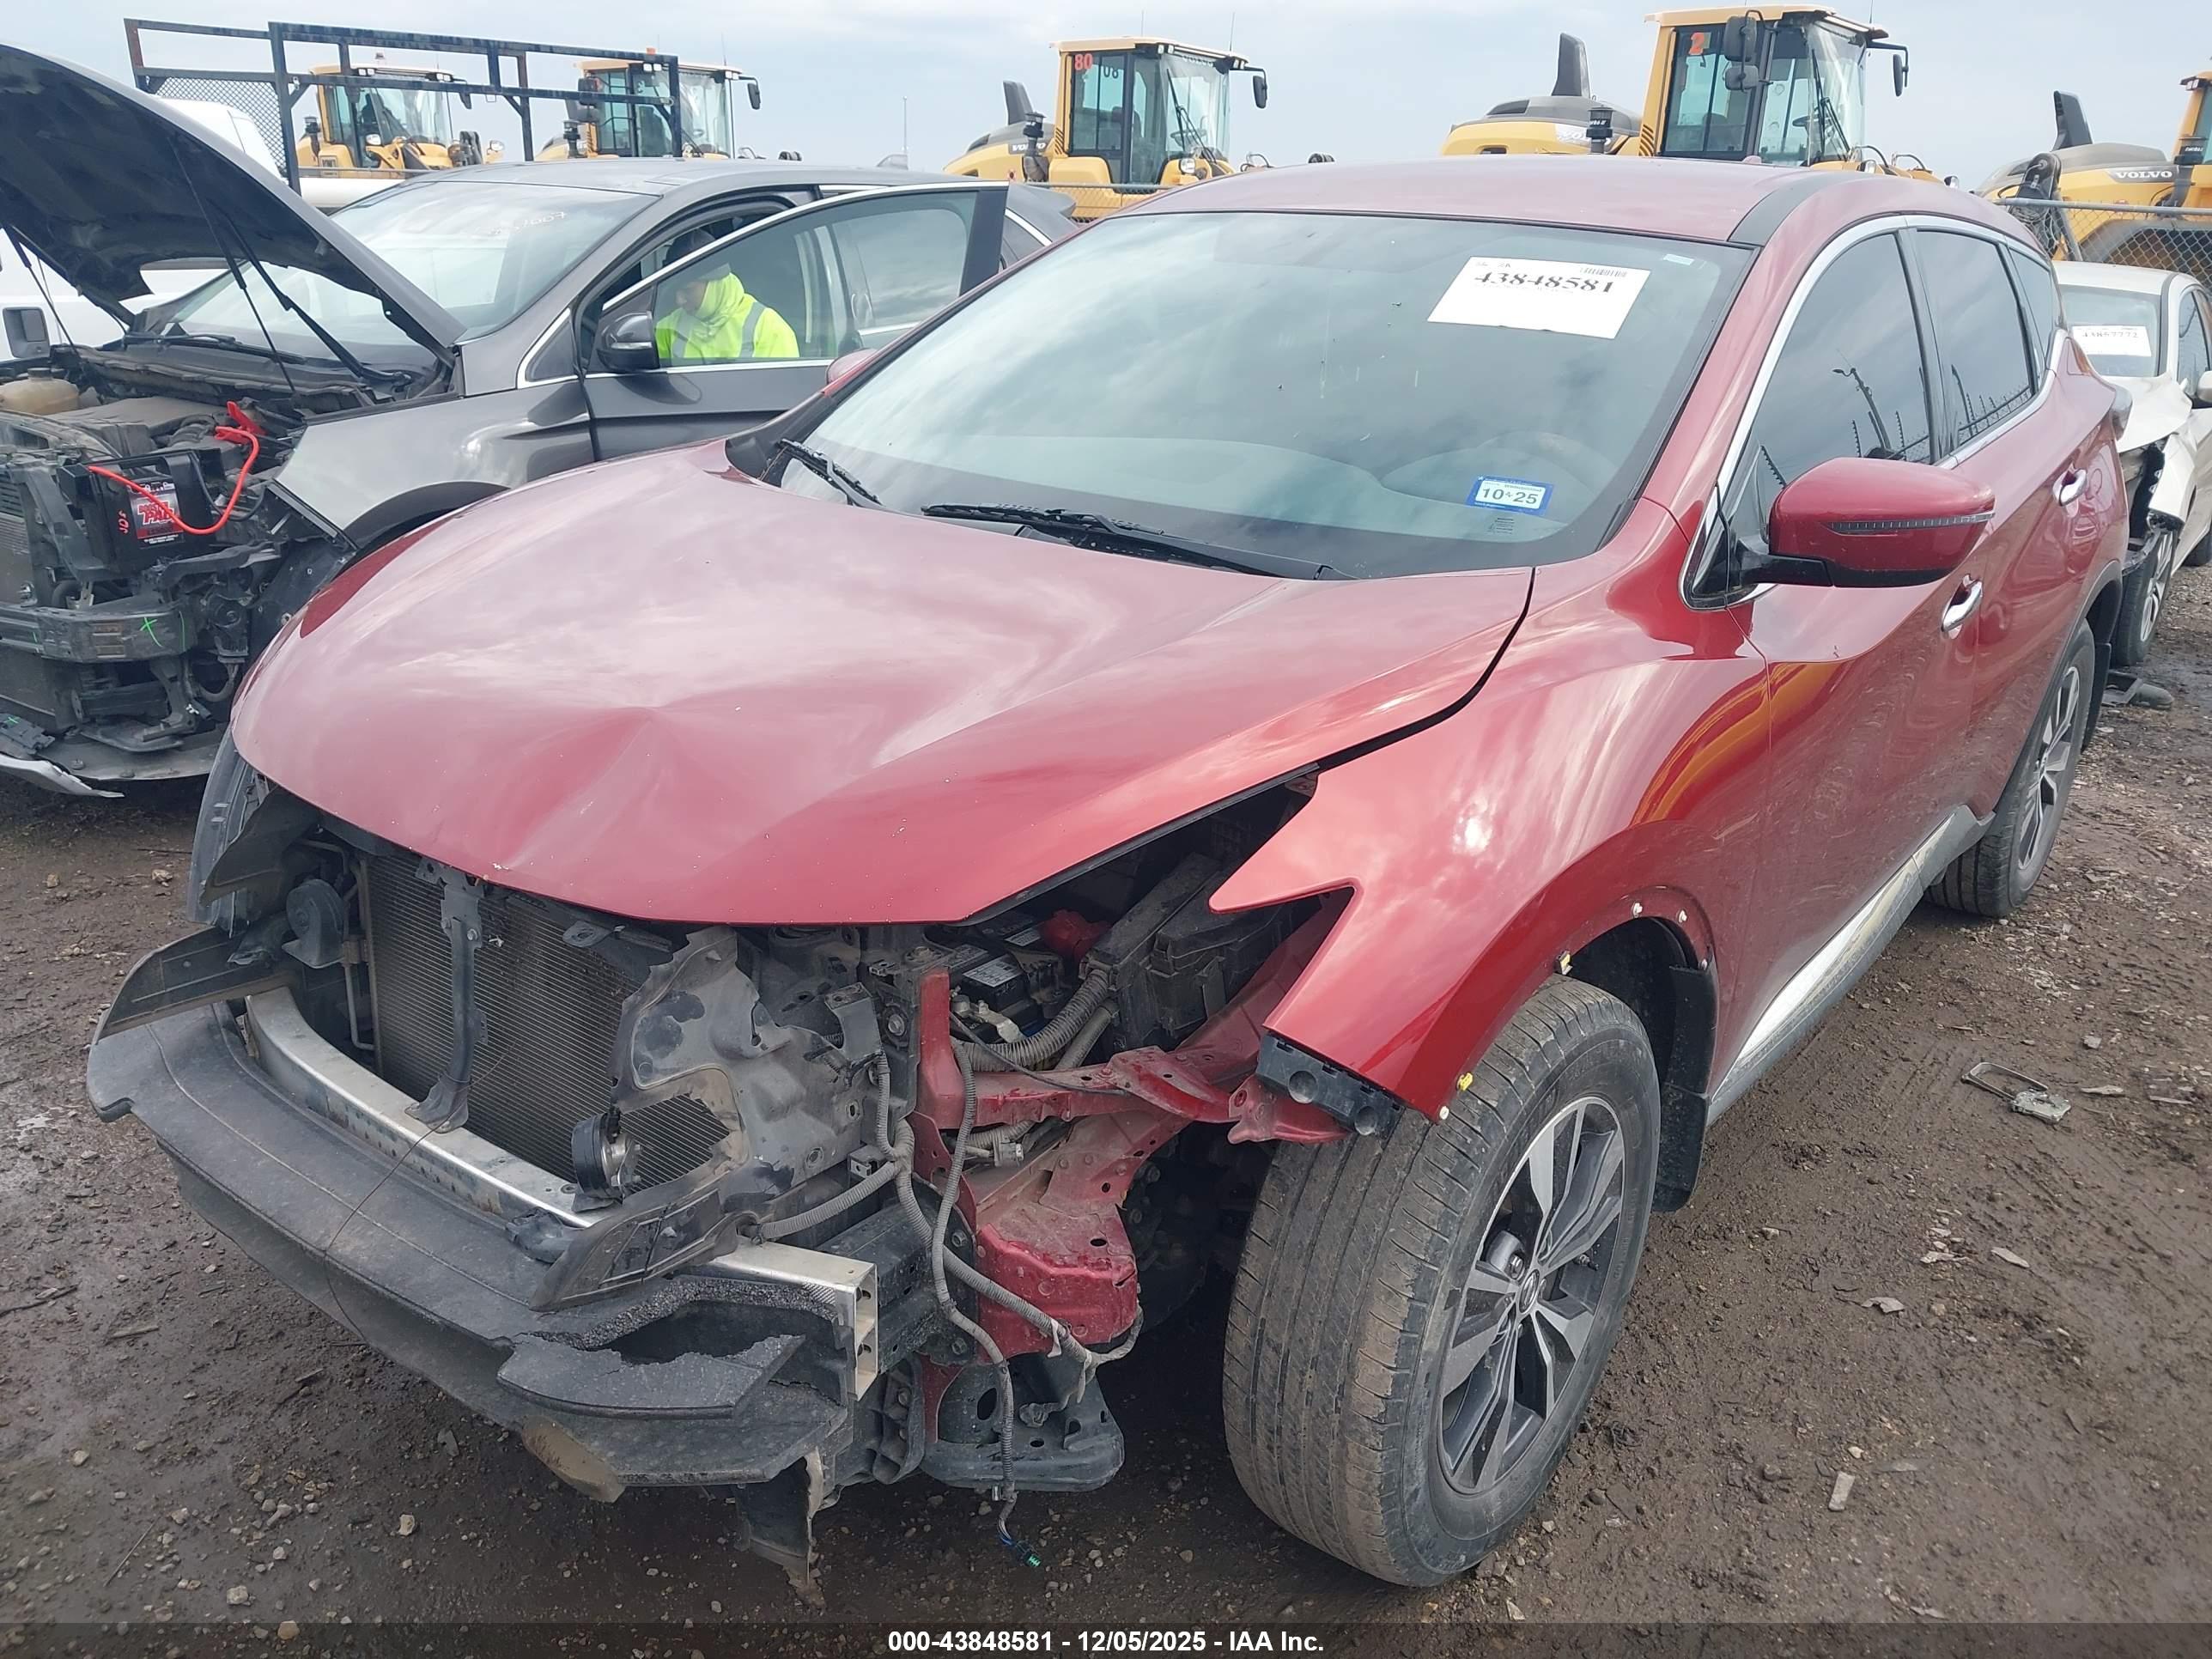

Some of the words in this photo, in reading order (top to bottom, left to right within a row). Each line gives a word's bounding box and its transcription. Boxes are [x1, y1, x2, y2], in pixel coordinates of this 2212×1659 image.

[1074, 53, 1093, 70] 80
[2116, 170, 2172, 179] VOLVO
[1474, 271, 1614, 293] 43848581
[1482, 488, 1504, 501] 10
[1513, 491, 1539, 505] 25
